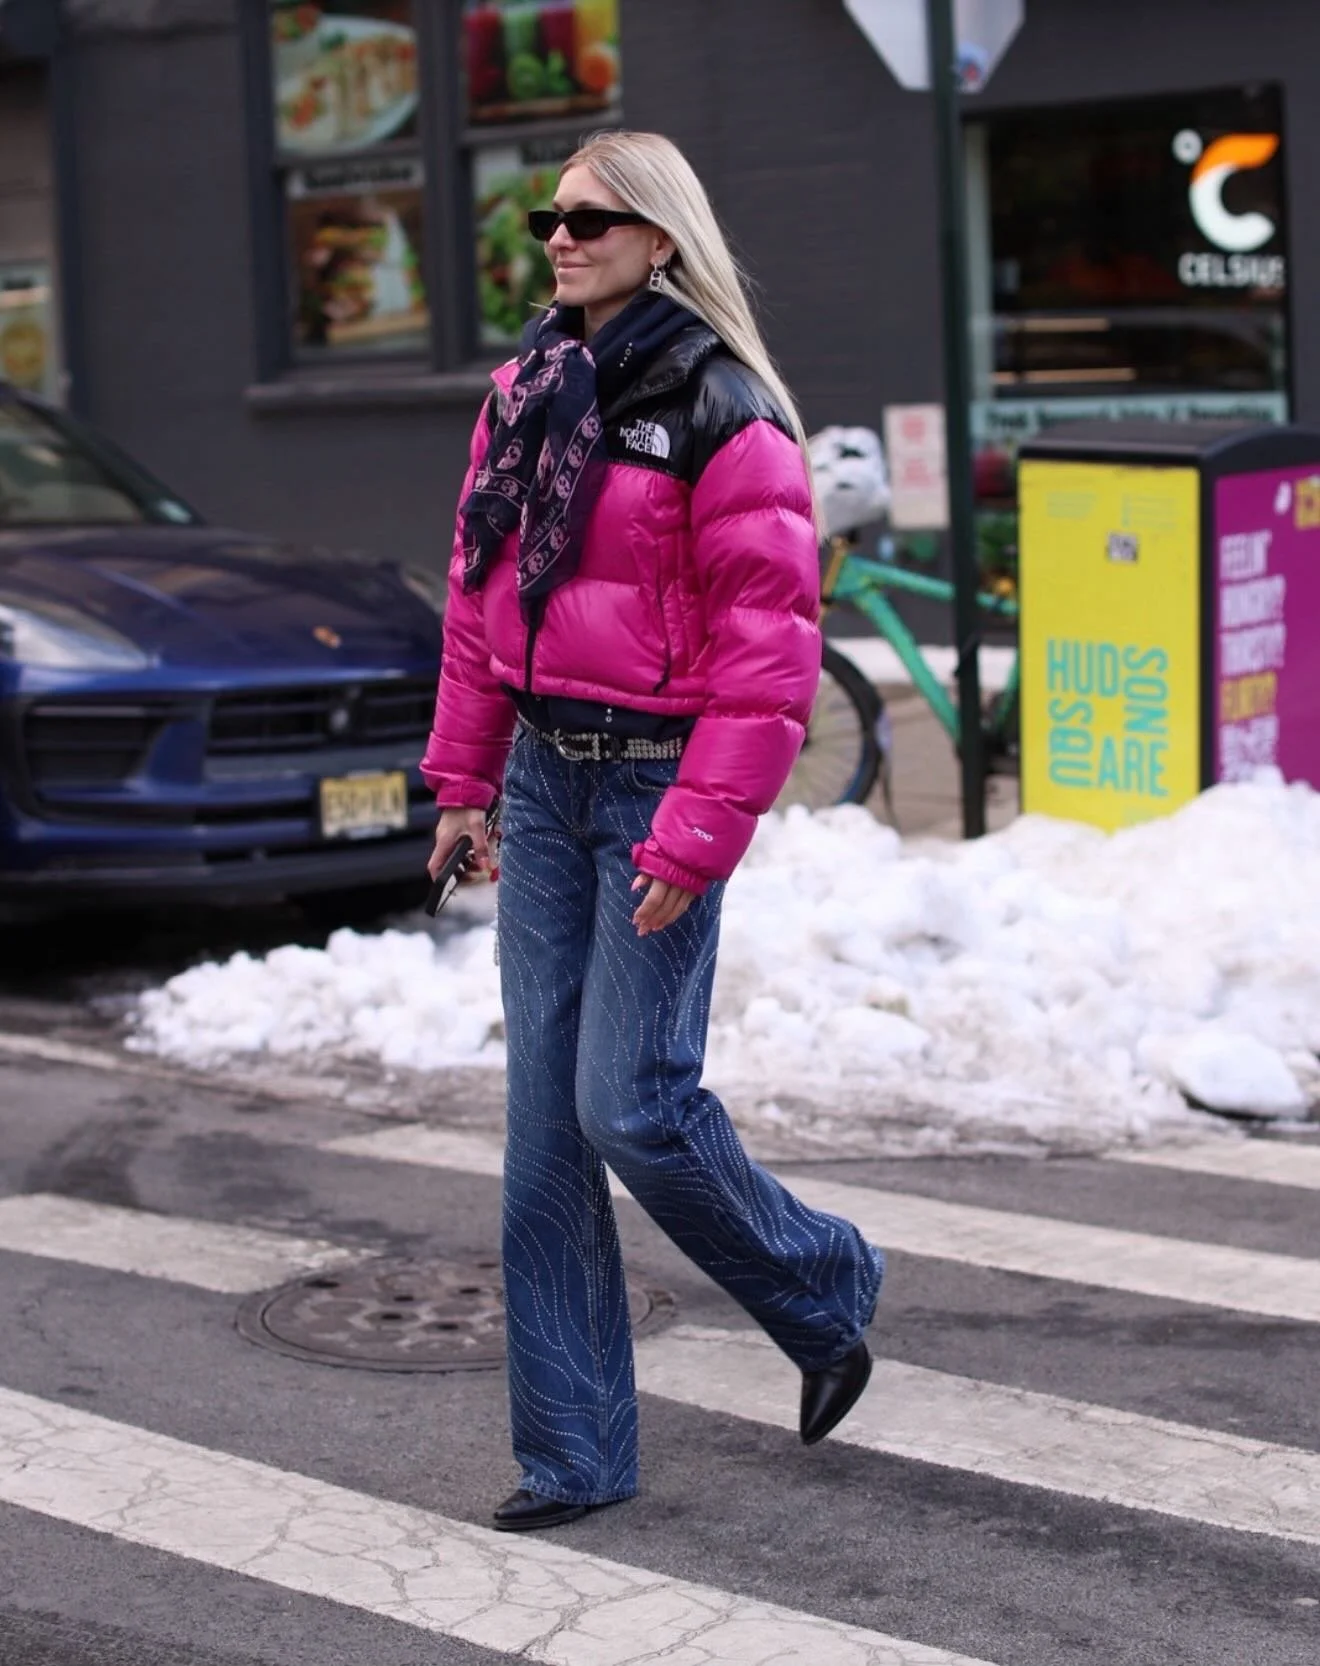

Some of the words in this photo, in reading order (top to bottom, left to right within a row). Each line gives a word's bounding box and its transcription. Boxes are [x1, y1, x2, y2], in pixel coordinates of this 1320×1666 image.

[636, 419, 655, 433] THE
[620, 426, 655, 446] NORTH
[626, 436, 653, 454] FACE
[692, 826, 713, 842] 700
